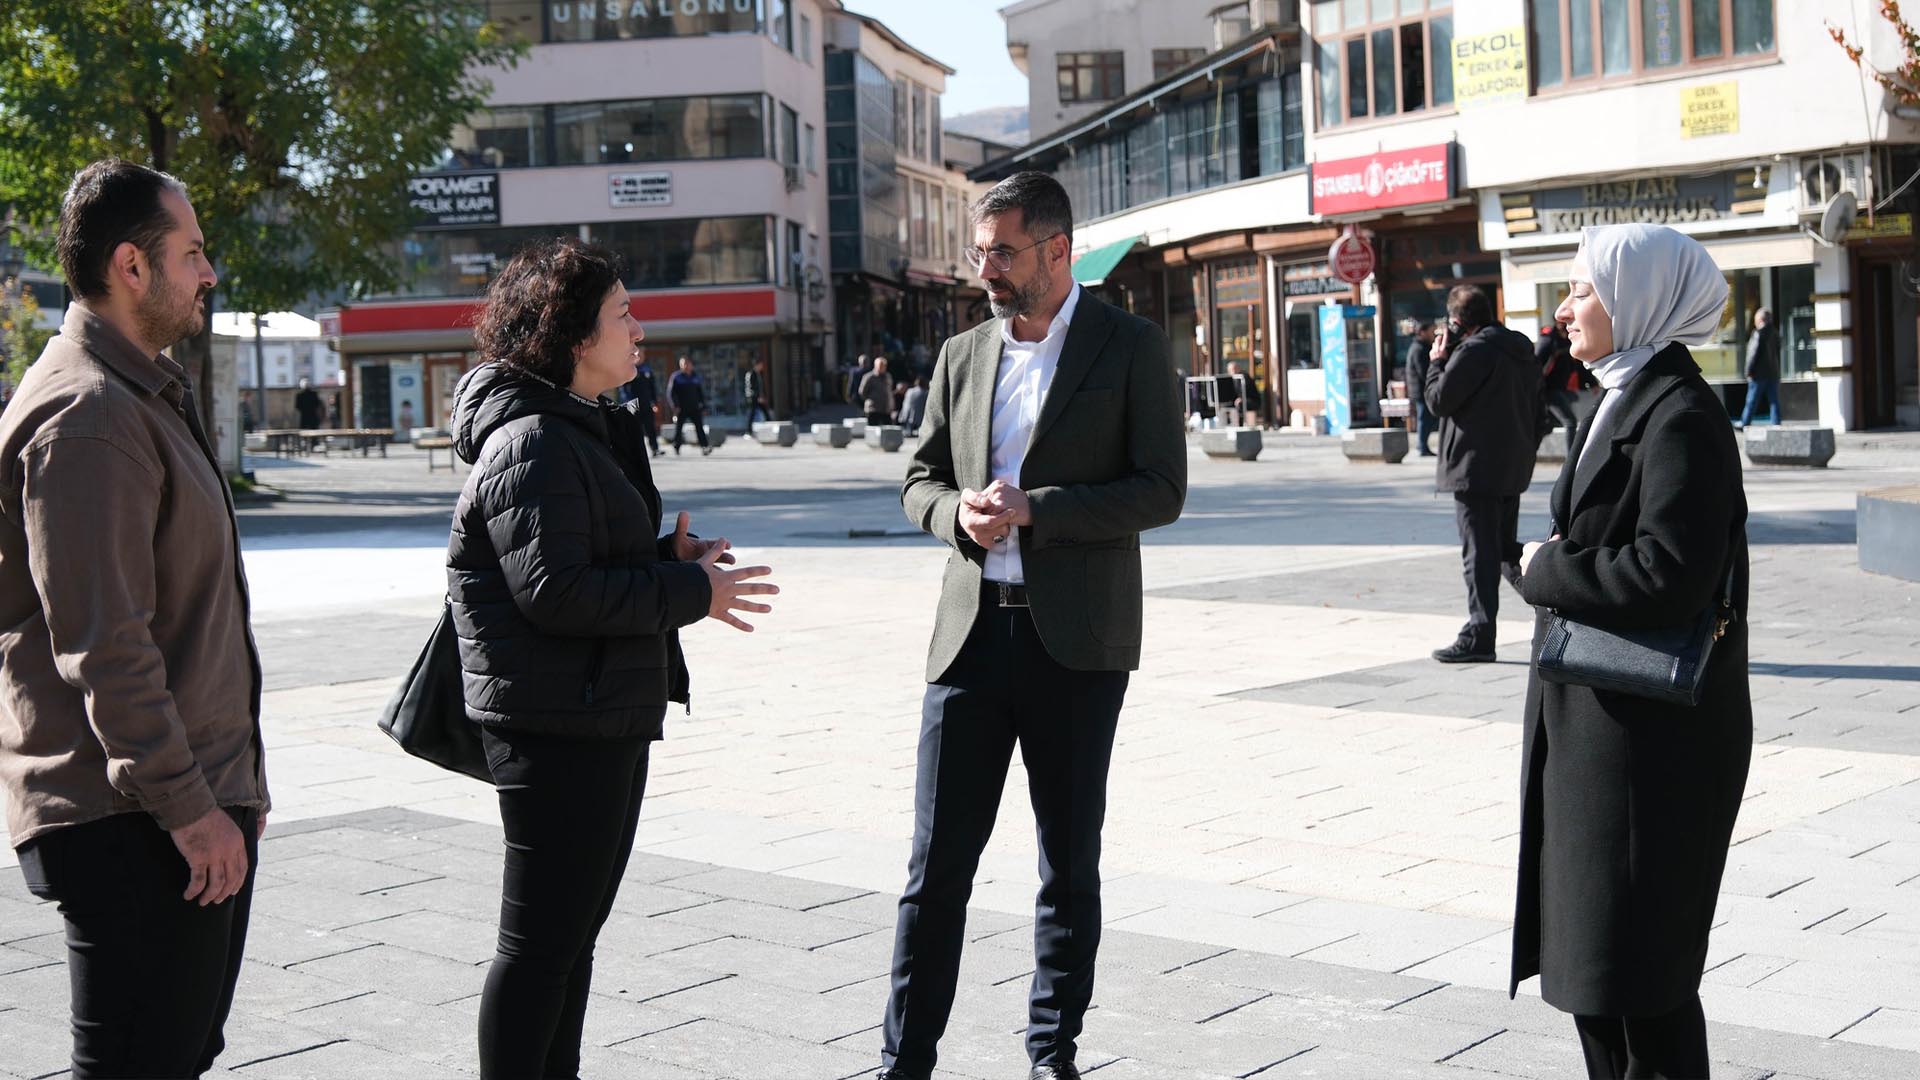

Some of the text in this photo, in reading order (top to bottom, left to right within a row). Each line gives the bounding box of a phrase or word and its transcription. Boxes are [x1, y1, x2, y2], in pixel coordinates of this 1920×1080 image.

[1456, 33, 1521, 58] EKOL
[1470, 57, 1509, 76] ERKEK
[456, 196, 494, 212] KAPI
